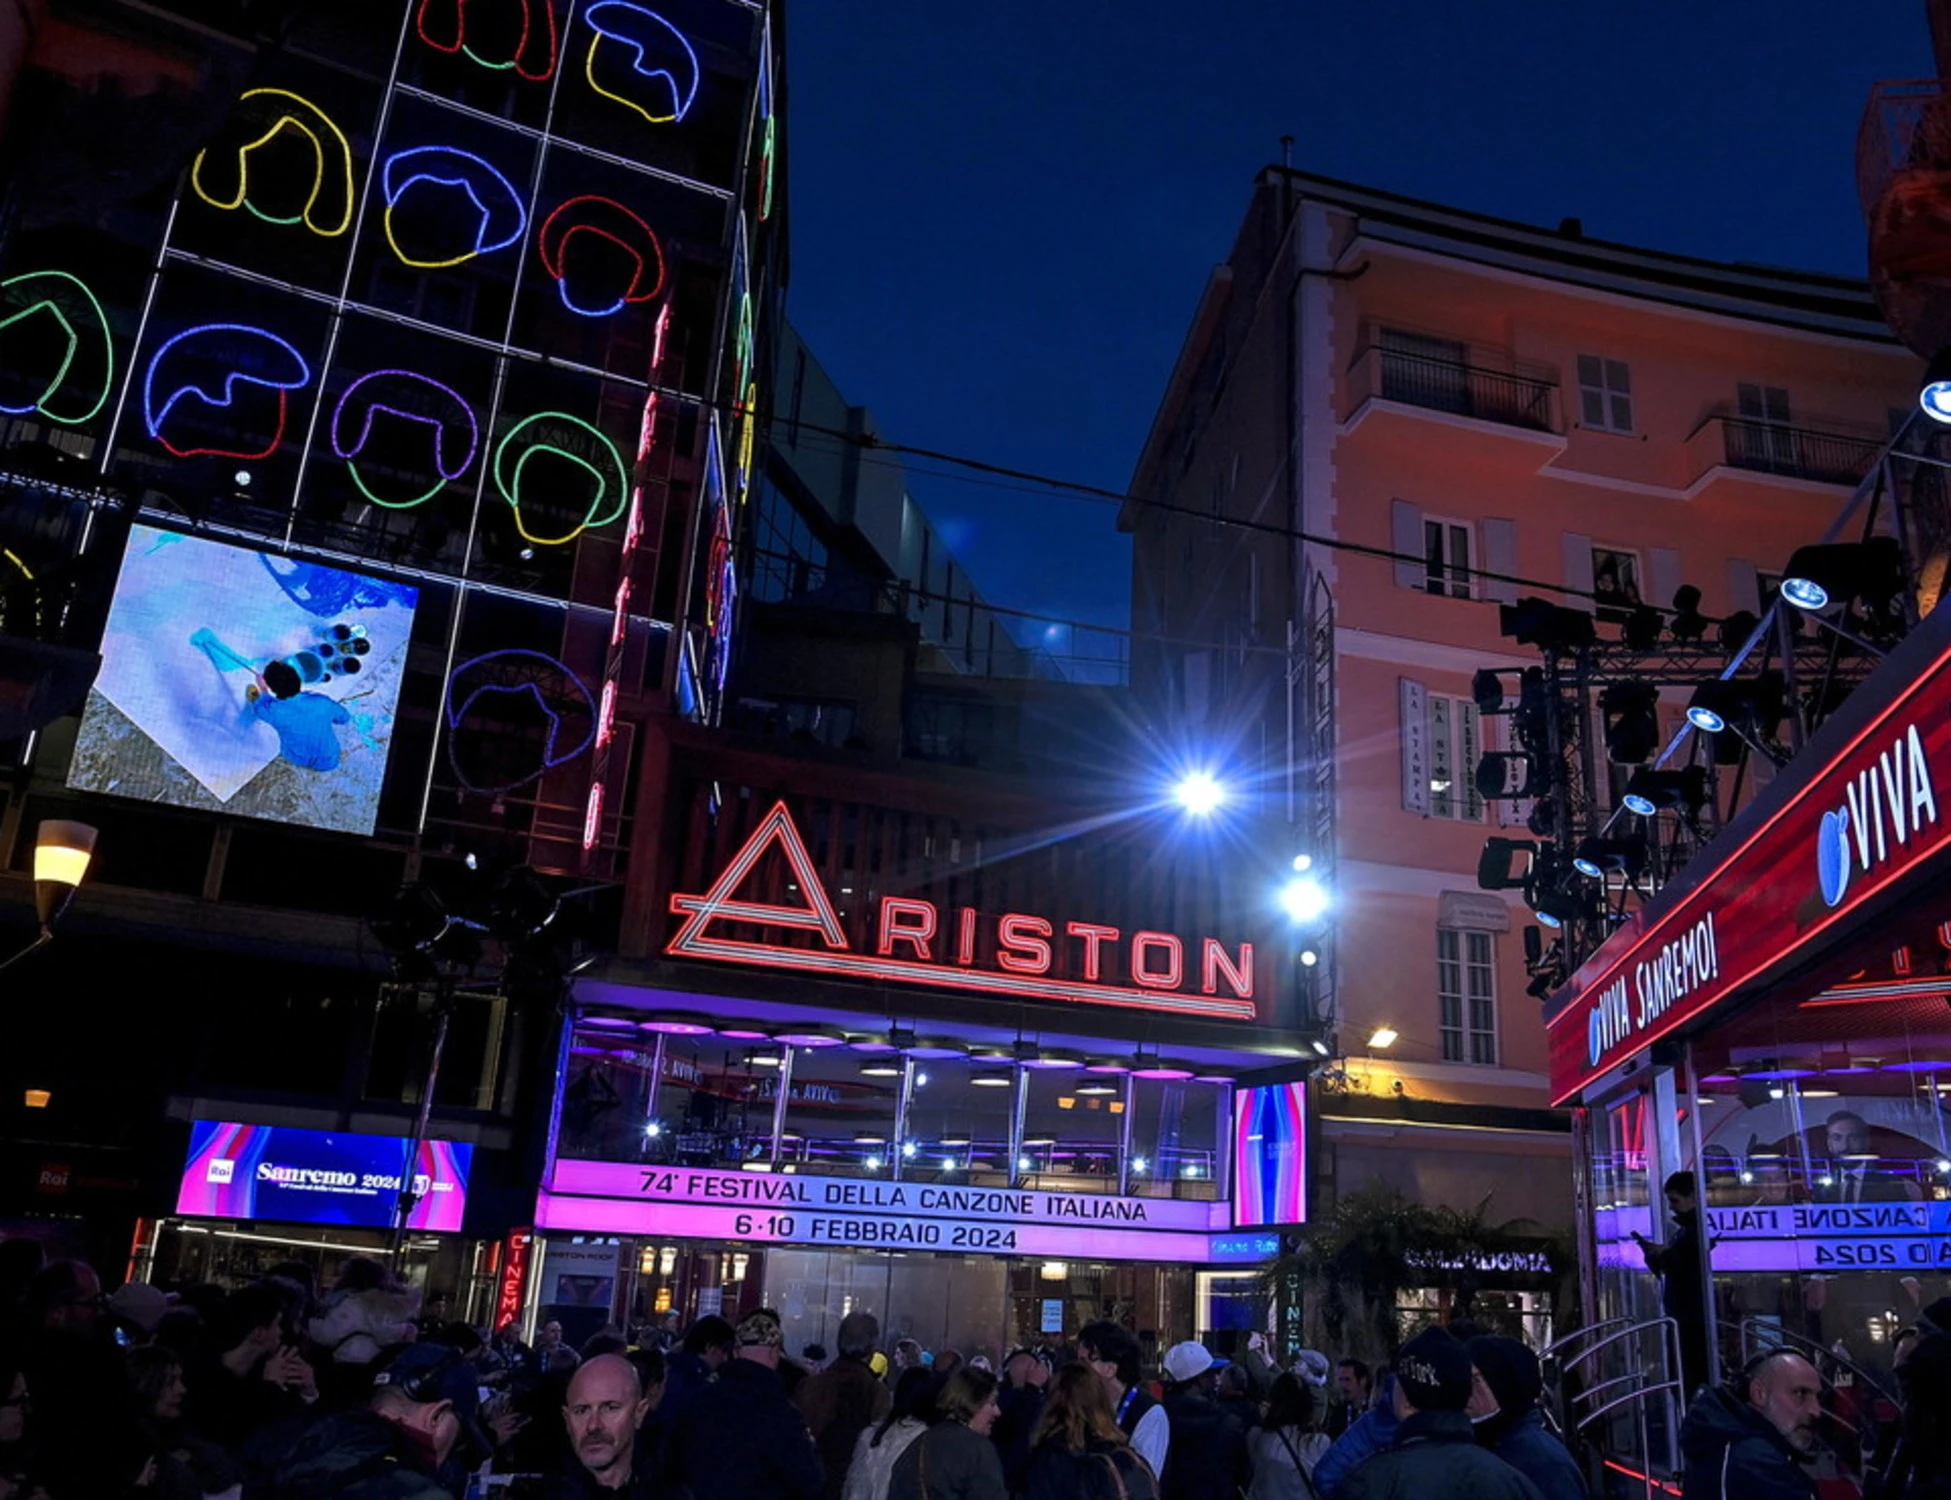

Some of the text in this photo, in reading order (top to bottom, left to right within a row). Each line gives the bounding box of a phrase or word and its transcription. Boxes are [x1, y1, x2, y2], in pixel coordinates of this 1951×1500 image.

[1846, 724, 1936, 870] VIVA
[664, 799, 1255, 1000] ARISTON
[1599, 975, 1631, 1051] VIVA
[210, 1165, 231, 1177] Rai
[256, 1162, 357, 1187] Sanremo
[361, 1174, 402, 1189] 2024
[687, 1175, 812, 1203] FESTIVAL
[825, 1184, 907, 1206] DELLA
[919, 1188, 1034, 1214] CANZONE
[1046, 1195, 1148, 1221] ITALIANA
[811, 1219, 940, 1244] FEBBRAIO
[952, 1226, 1018, 1249] 2024
[500, 1234, 526, 1328] CINEMA
